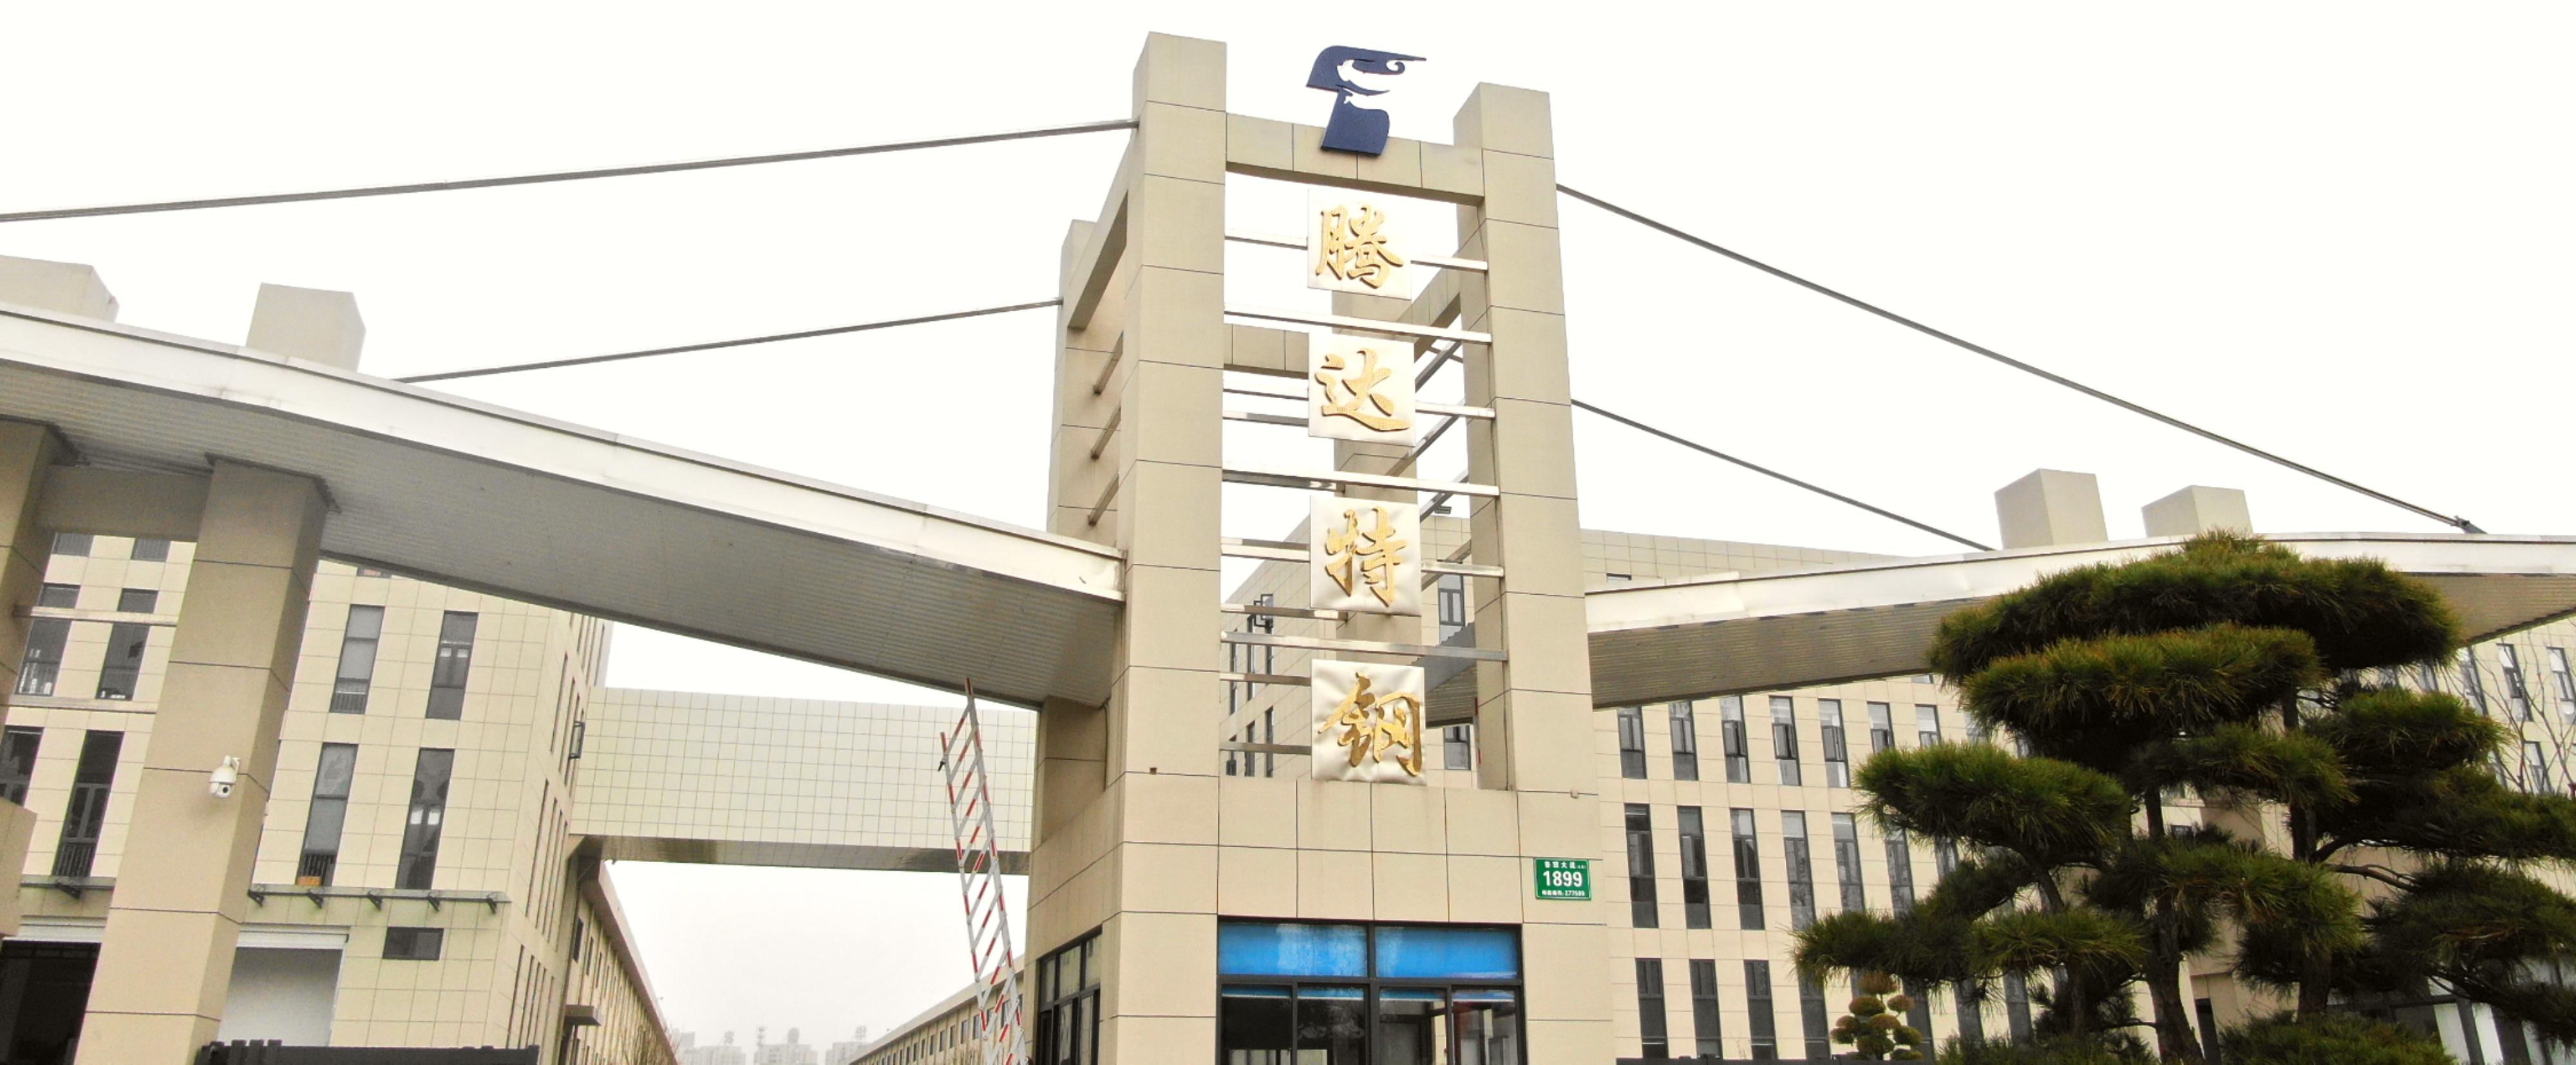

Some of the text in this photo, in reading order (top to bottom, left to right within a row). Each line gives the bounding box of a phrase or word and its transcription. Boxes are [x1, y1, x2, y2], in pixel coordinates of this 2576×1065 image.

[1314, 205, 1423, 777] 腾达特钢
[1543, 870, 1582, 887] 1899
